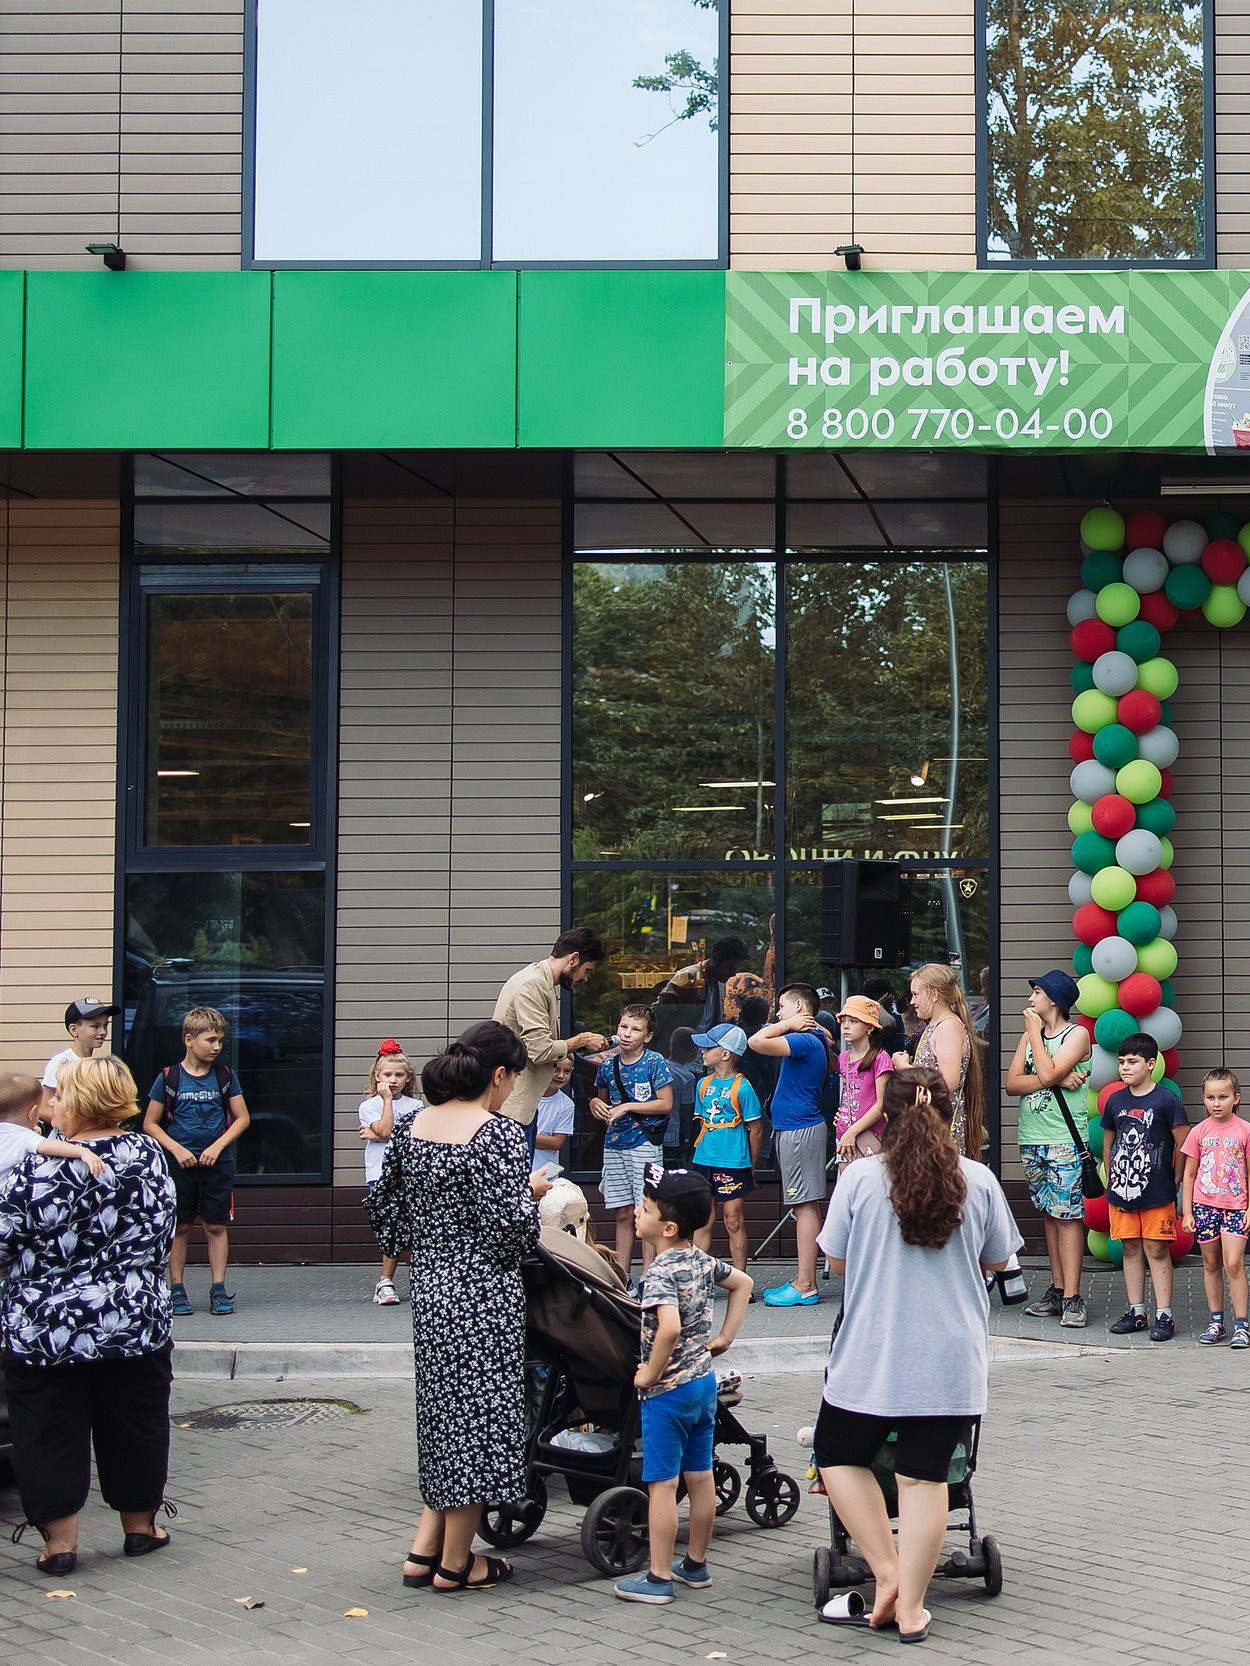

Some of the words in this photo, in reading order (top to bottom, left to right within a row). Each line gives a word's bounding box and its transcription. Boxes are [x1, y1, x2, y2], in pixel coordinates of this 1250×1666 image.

[788, 297, 1125, 344] Приглашаем
[788, 356, 851, 387] на
[869, 346, 1070, 396] работу!
[786, 407, 808, 440] 8
[821, 407, 895, 440] 800
[907, 407, 1113, 440] 770-04-00
